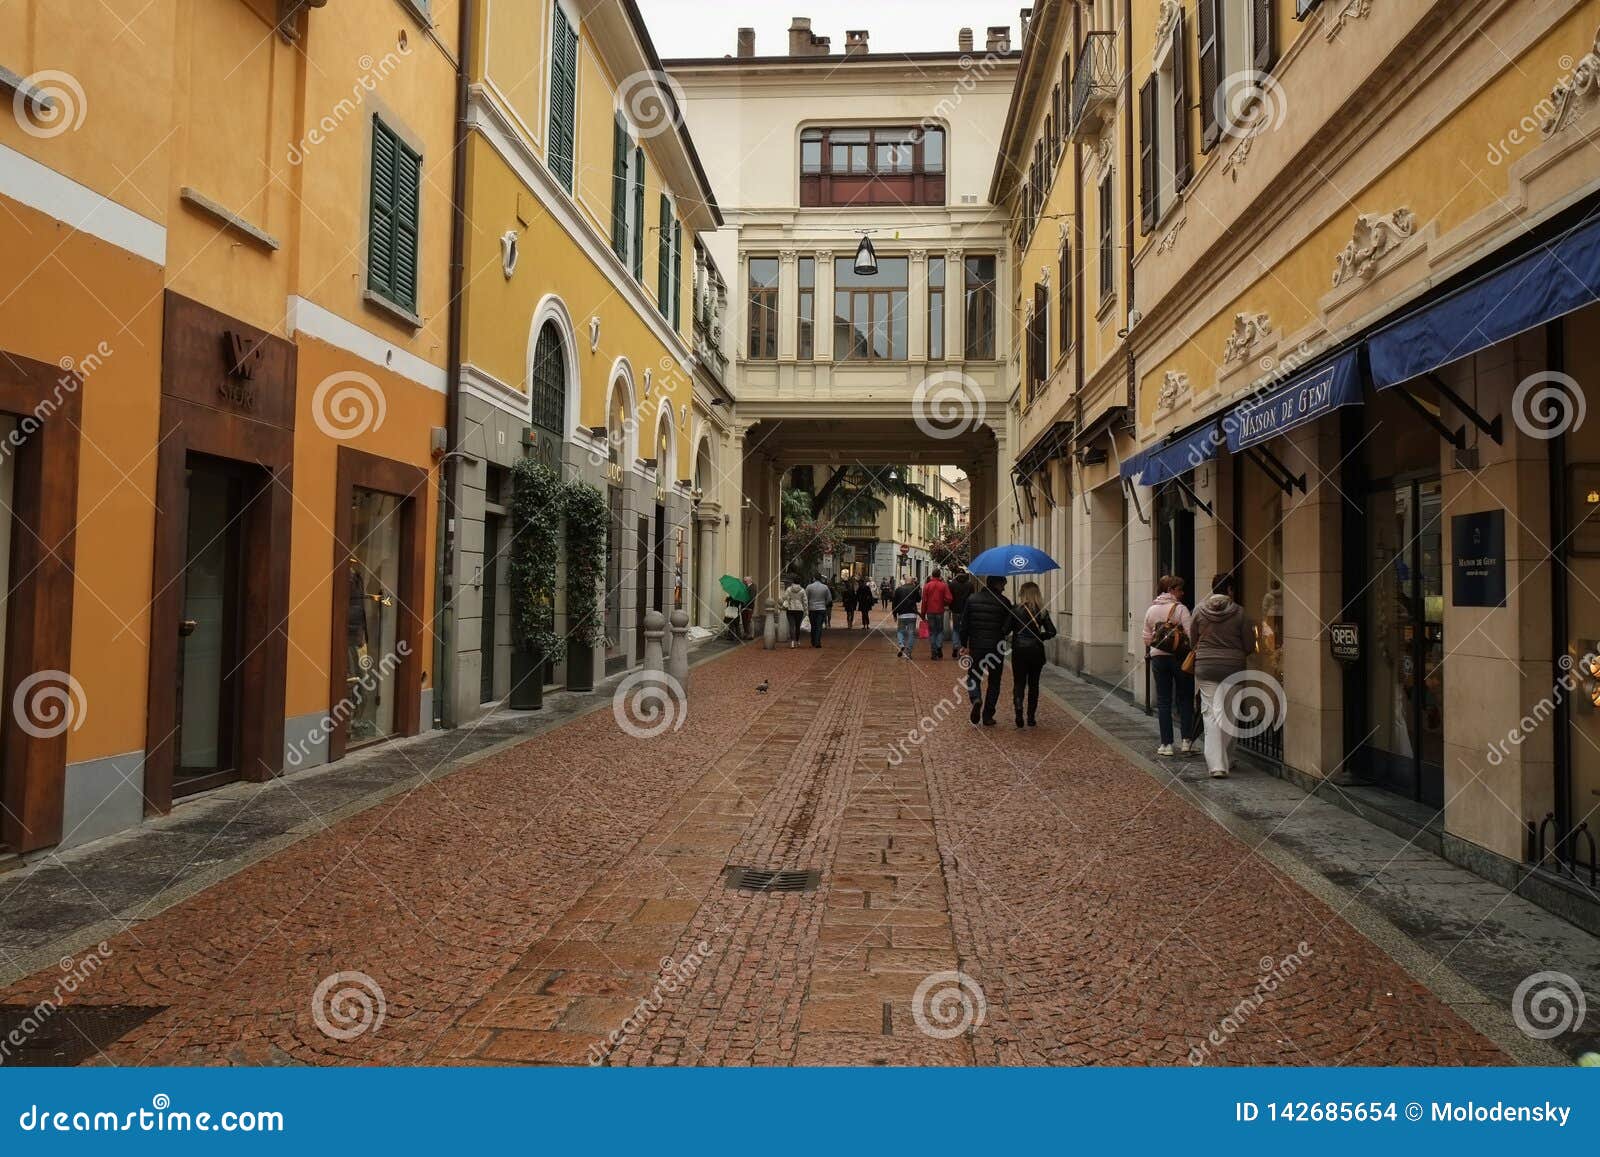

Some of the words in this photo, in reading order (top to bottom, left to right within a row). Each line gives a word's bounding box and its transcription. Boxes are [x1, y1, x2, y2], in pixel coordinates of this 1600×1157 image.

[1241, 407, 1276, 439] MAISON
[1281, 398, 1294, 421] DE
[1298, 379, 1331, 413] GENY
[1333, 628, 1358, 646] OPEN
